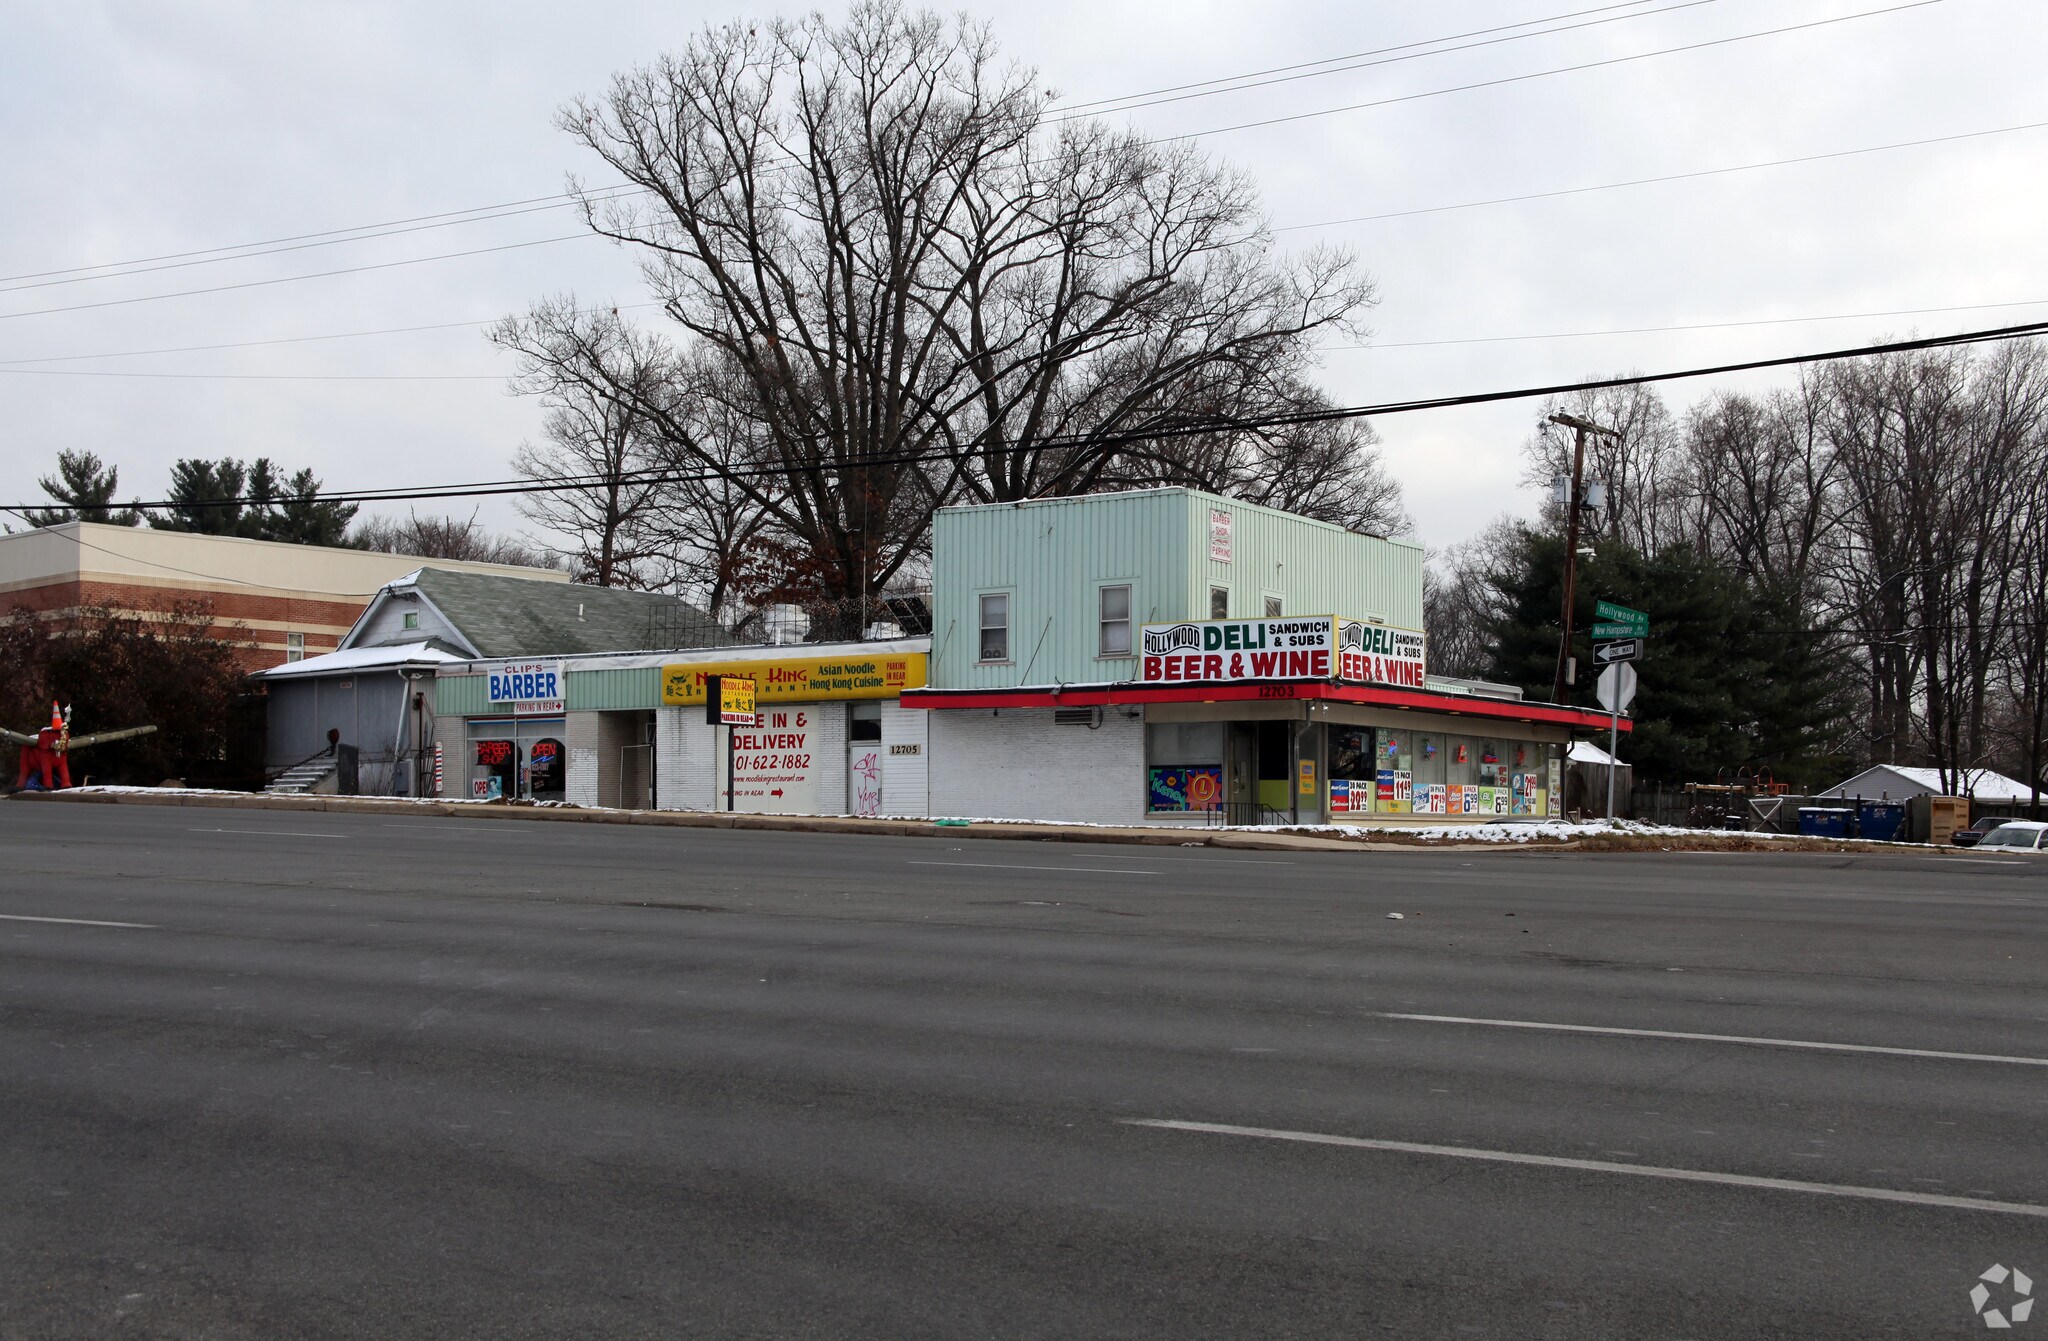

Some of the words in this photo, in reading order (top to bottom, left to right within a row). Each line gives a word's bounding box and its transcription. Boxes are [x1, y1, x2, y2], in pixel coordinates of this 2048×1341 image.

[1212, 514, 1230, 526] BARBER
[1212, 546, 1230, 558] PARKING
[1600, 604, 1635, 622] Hollywood
[1268, 622, 1330, 635] SANDWICH
[1594, 626, 1606, 634] New
[1606, 625, 1632, 636] Hampshire
[1144, 626, 1200, 653] HOLLYWOOD
[1204, 623, 1266, 650] DELI
[1274, 637, 1282, 647] &
[1289, 634, 1325, 646] SUBS
[1339, 625, 1362, 649] LLYWOOD
[1362, 626, 1394, 656] DELI
[1395, 634, 1423, 646] SANDWICH
[1397, 646, 1401, 656] &
[1404, 648, 1421, 658] SUBS
[1610, 648, 1619, 656] ONE
[504, 664, 542, 674] CLIP'S
[818, 666, 842, 676] Asian
[845, 662, 875, 674] Noodle
[886, 662, 906, 670] PARKING
[1144, 654, 1222, 681] BEER
[1229, 652, 1244, 678] &
[1250, 650, 1330, 677] WINE
[1375, 656, 1383, 682] &
[1384, 658, 1423, 687] WINE
[765, 668, 807, 683] KING
[886, 672, 891, 680] IN
[893, 672, 905, 680] REAR
[490, 672, 557, 700] BARBER
[722, 680, 741, 691] NOODLE
[810, 679, 830, 691] Hong
[832, 679, 852, 690] Kong
[854, 677, 883, 688] Cuisine
[1258, 686, 1295, 698] 12703
[516, 702, 535, 712] PARKING
[537, 702, 542, 711] IN
[544, 702, 555, 711] REAR
[722, 714, 735, 722] PARKING
[736, 714, 740, 722] IN
[772, 713, 787, 728] IN
[796, 712, 807, 728] &
[476, 742, 511, 755] BARBER
[734, 734, 806, 750] DELIVERY
[531, 743, 557, 756] OPEN
[891, 745, 917, 754] 12705
[482, 755, 504, 764] SHOP
[733, 754, 810, 770] 01-622-1882
[474, 781, 488, 794] OPE
[1152, 778, 1182, 802] Keno
[1356, 782, 1367, 790] PACK
